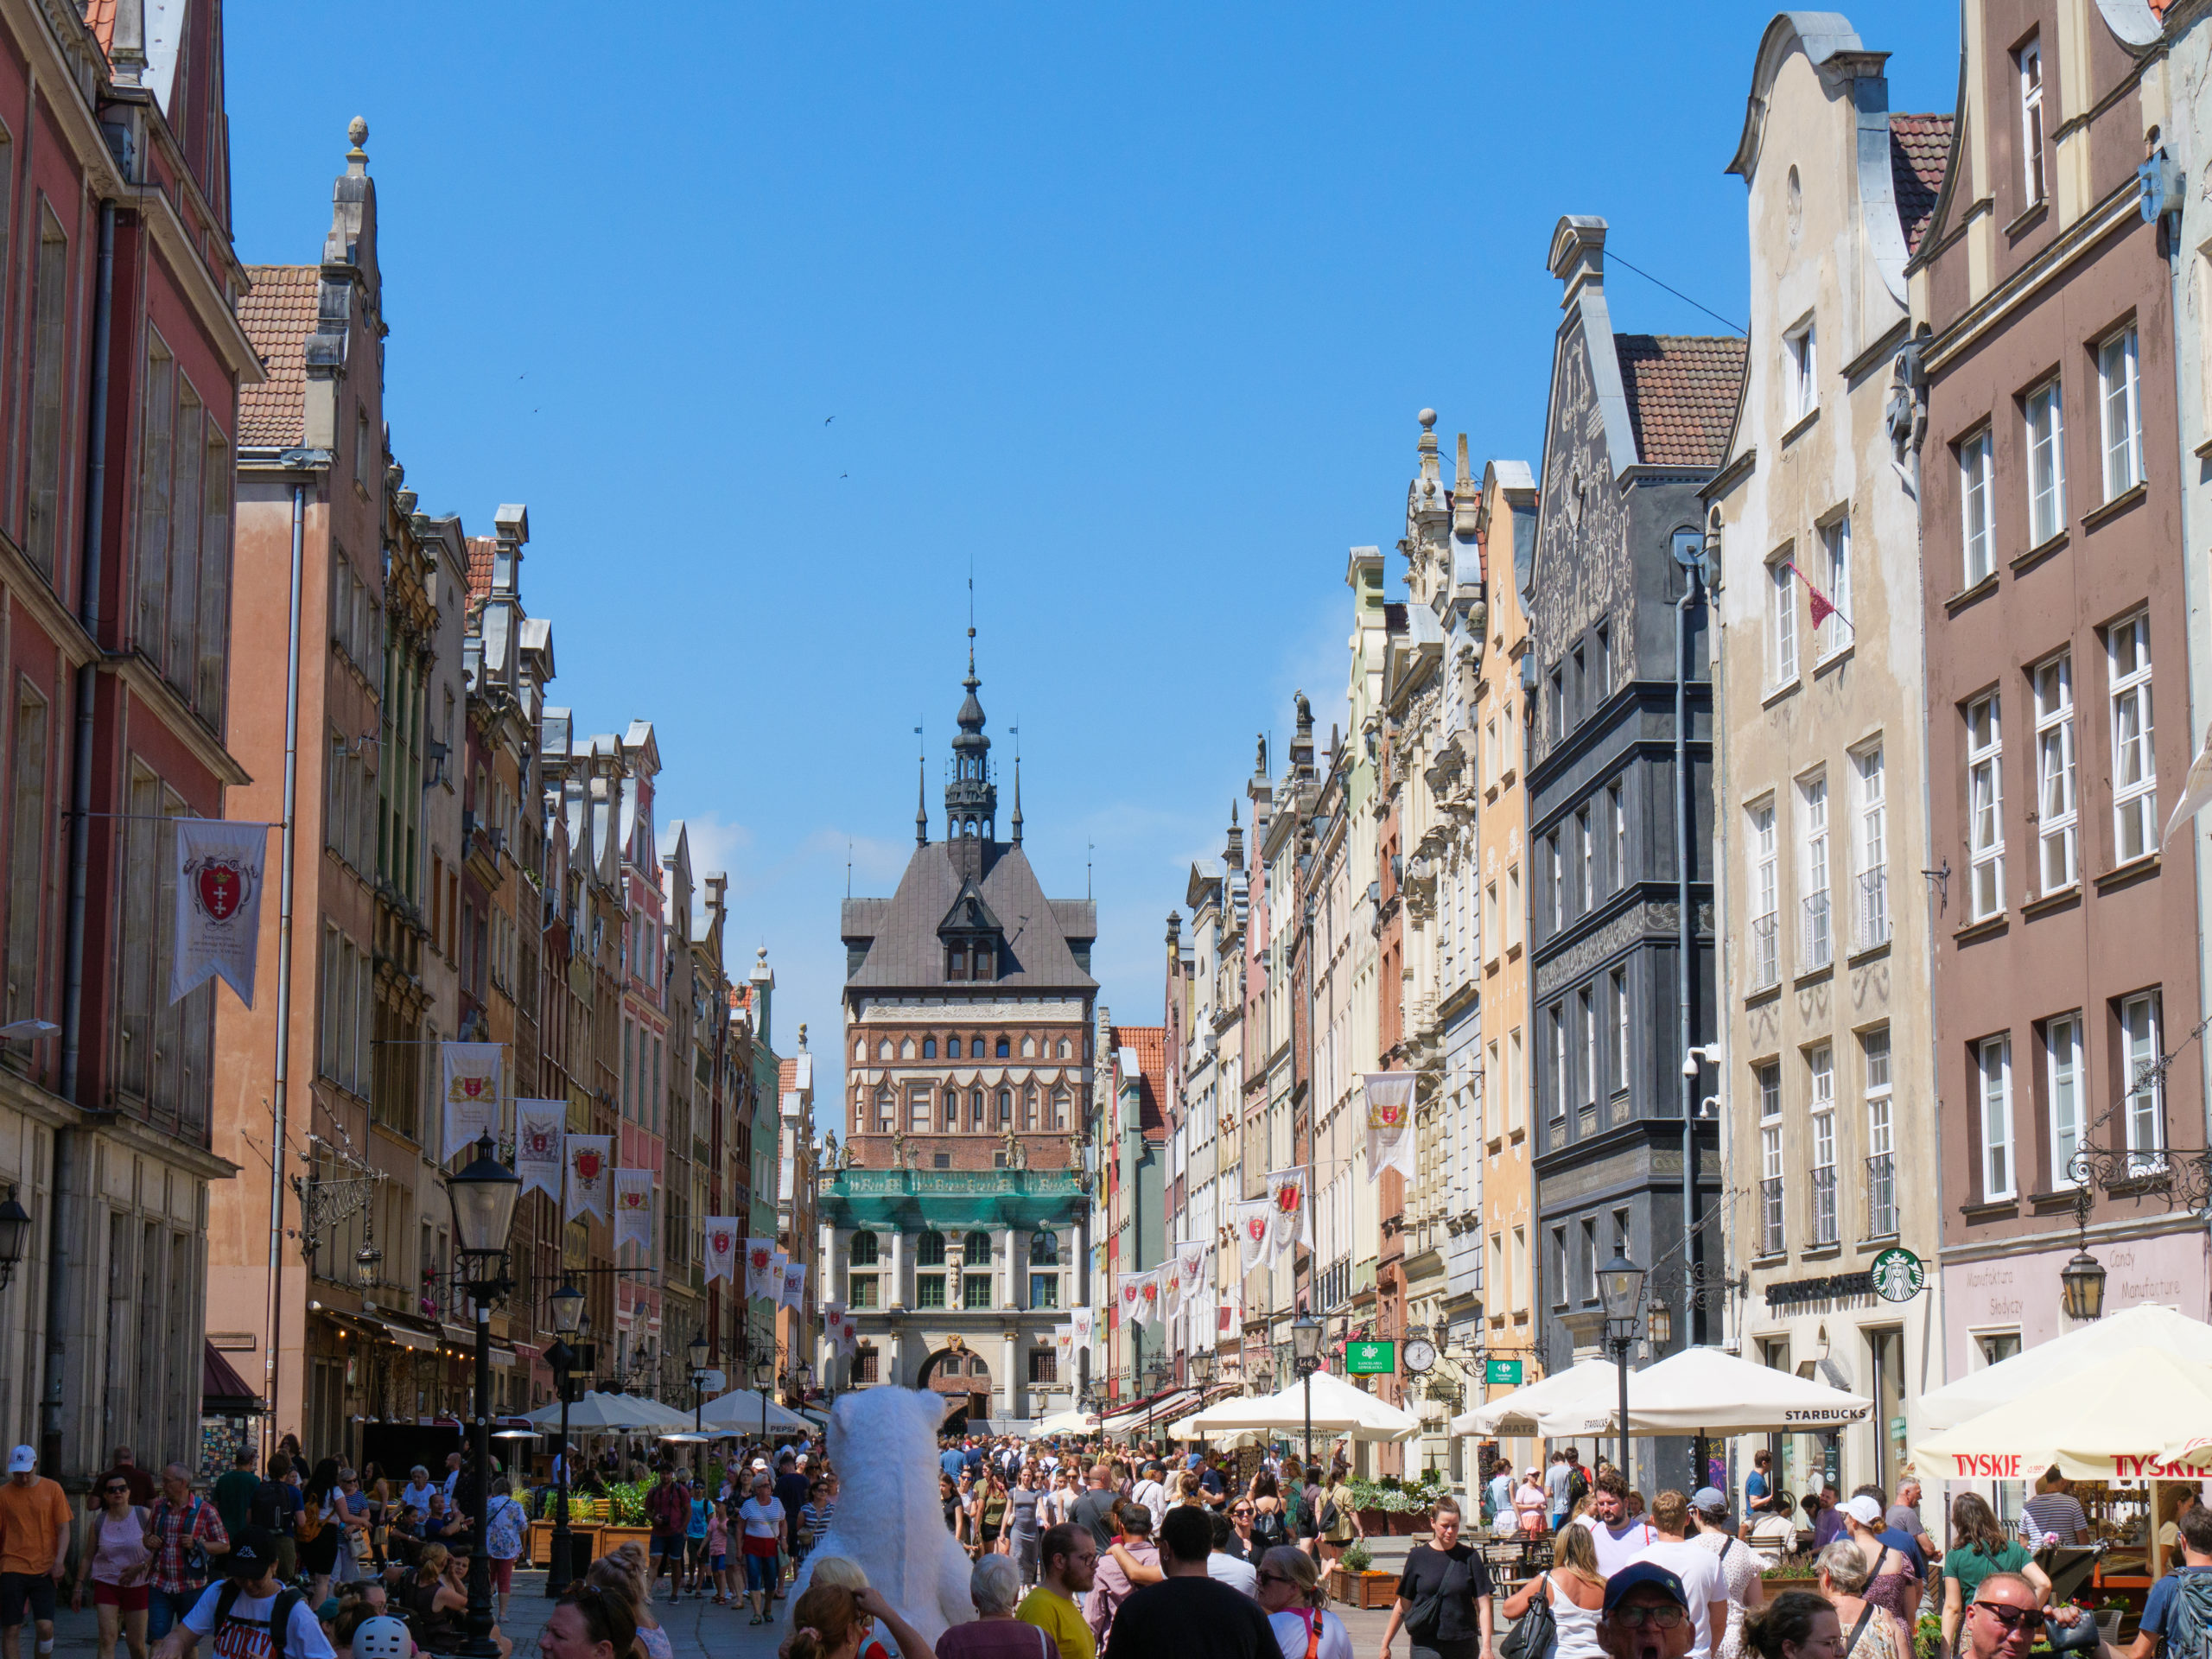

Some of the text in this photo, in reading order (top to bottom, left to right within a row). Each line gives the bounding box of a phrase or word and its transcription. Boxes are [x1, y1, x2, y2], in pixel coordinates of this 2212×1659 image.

[2110, 1250, 2135, 1270] Candy
[1967, 1268, 2013, 1287] Manufaktura
[2121, 1279, 2181, 1300] Manufacture
[1785, 1408, 1866, 1421] STARBUCKS
[1951, 1453, 2022, 1478] TYSKIE
